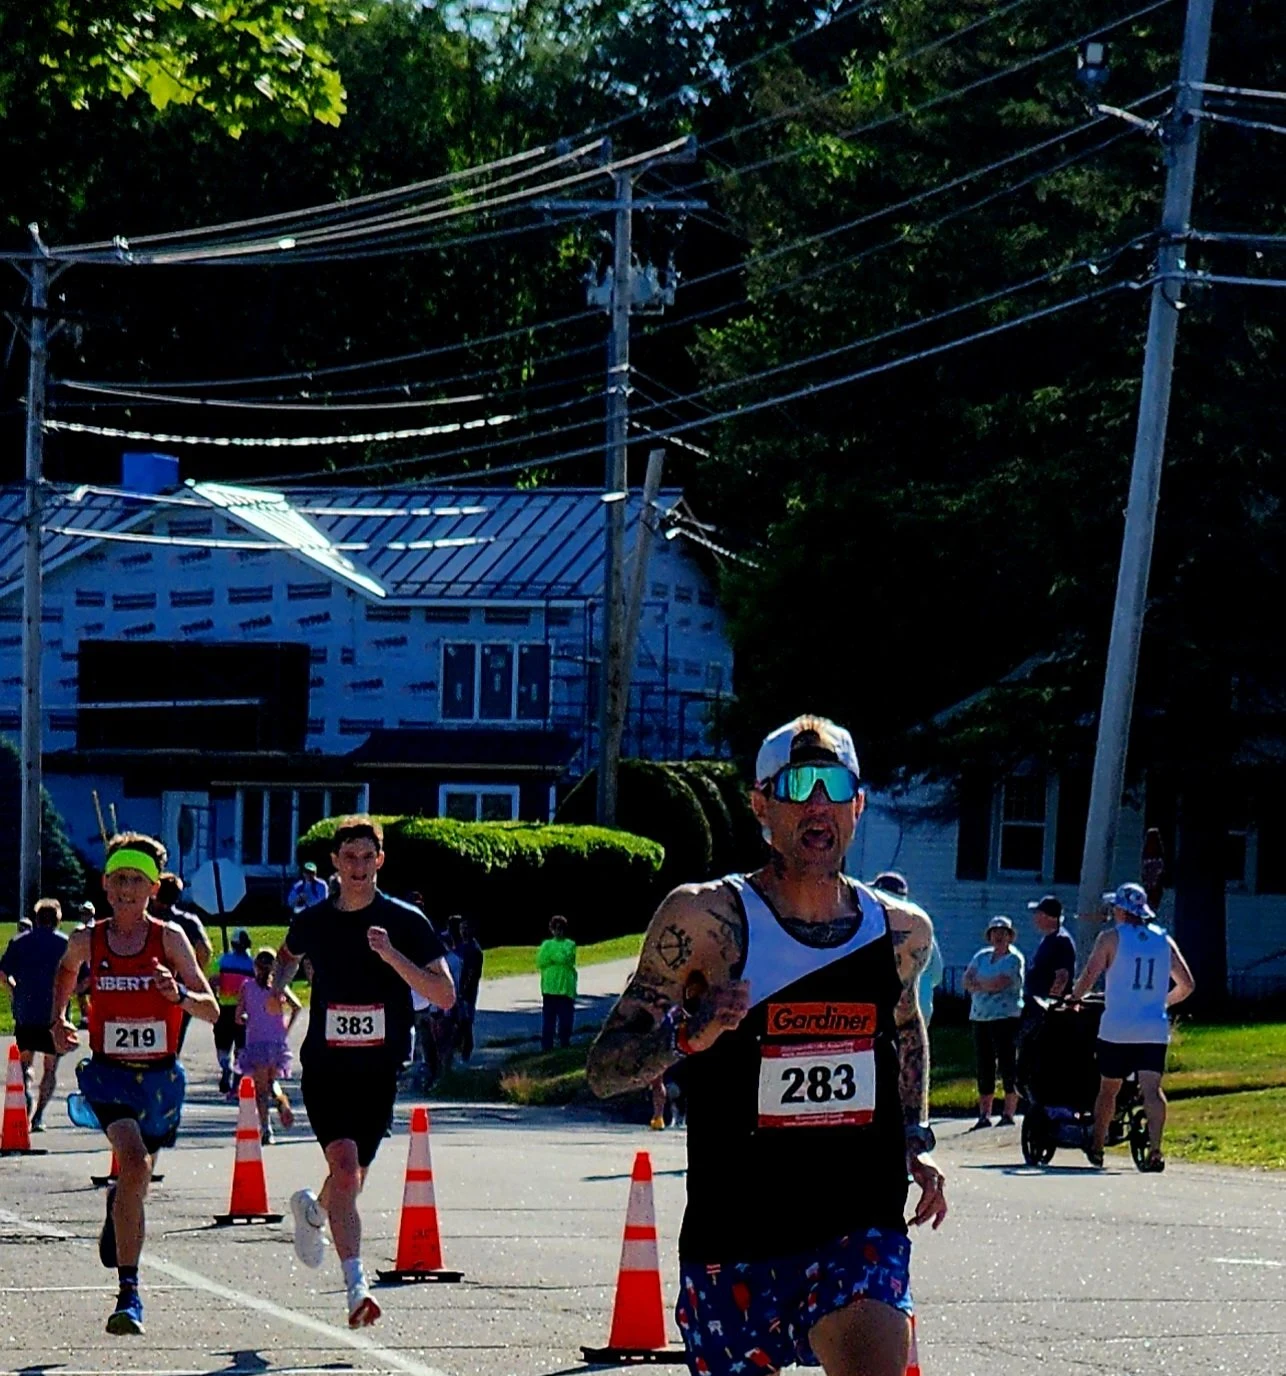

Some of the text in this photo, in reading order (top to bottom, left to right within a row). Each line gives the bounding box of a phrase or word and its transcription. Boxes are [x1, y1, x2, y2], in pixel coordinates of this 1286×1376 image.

[1132, 957, 1155, 989] 11
[336, 1016, 374, 1035] 383
[774, 1006, 870, 1030] Gardiner
[116, 1028, 156, 1048] 219
[780, 1063, 857, 1105] 283
